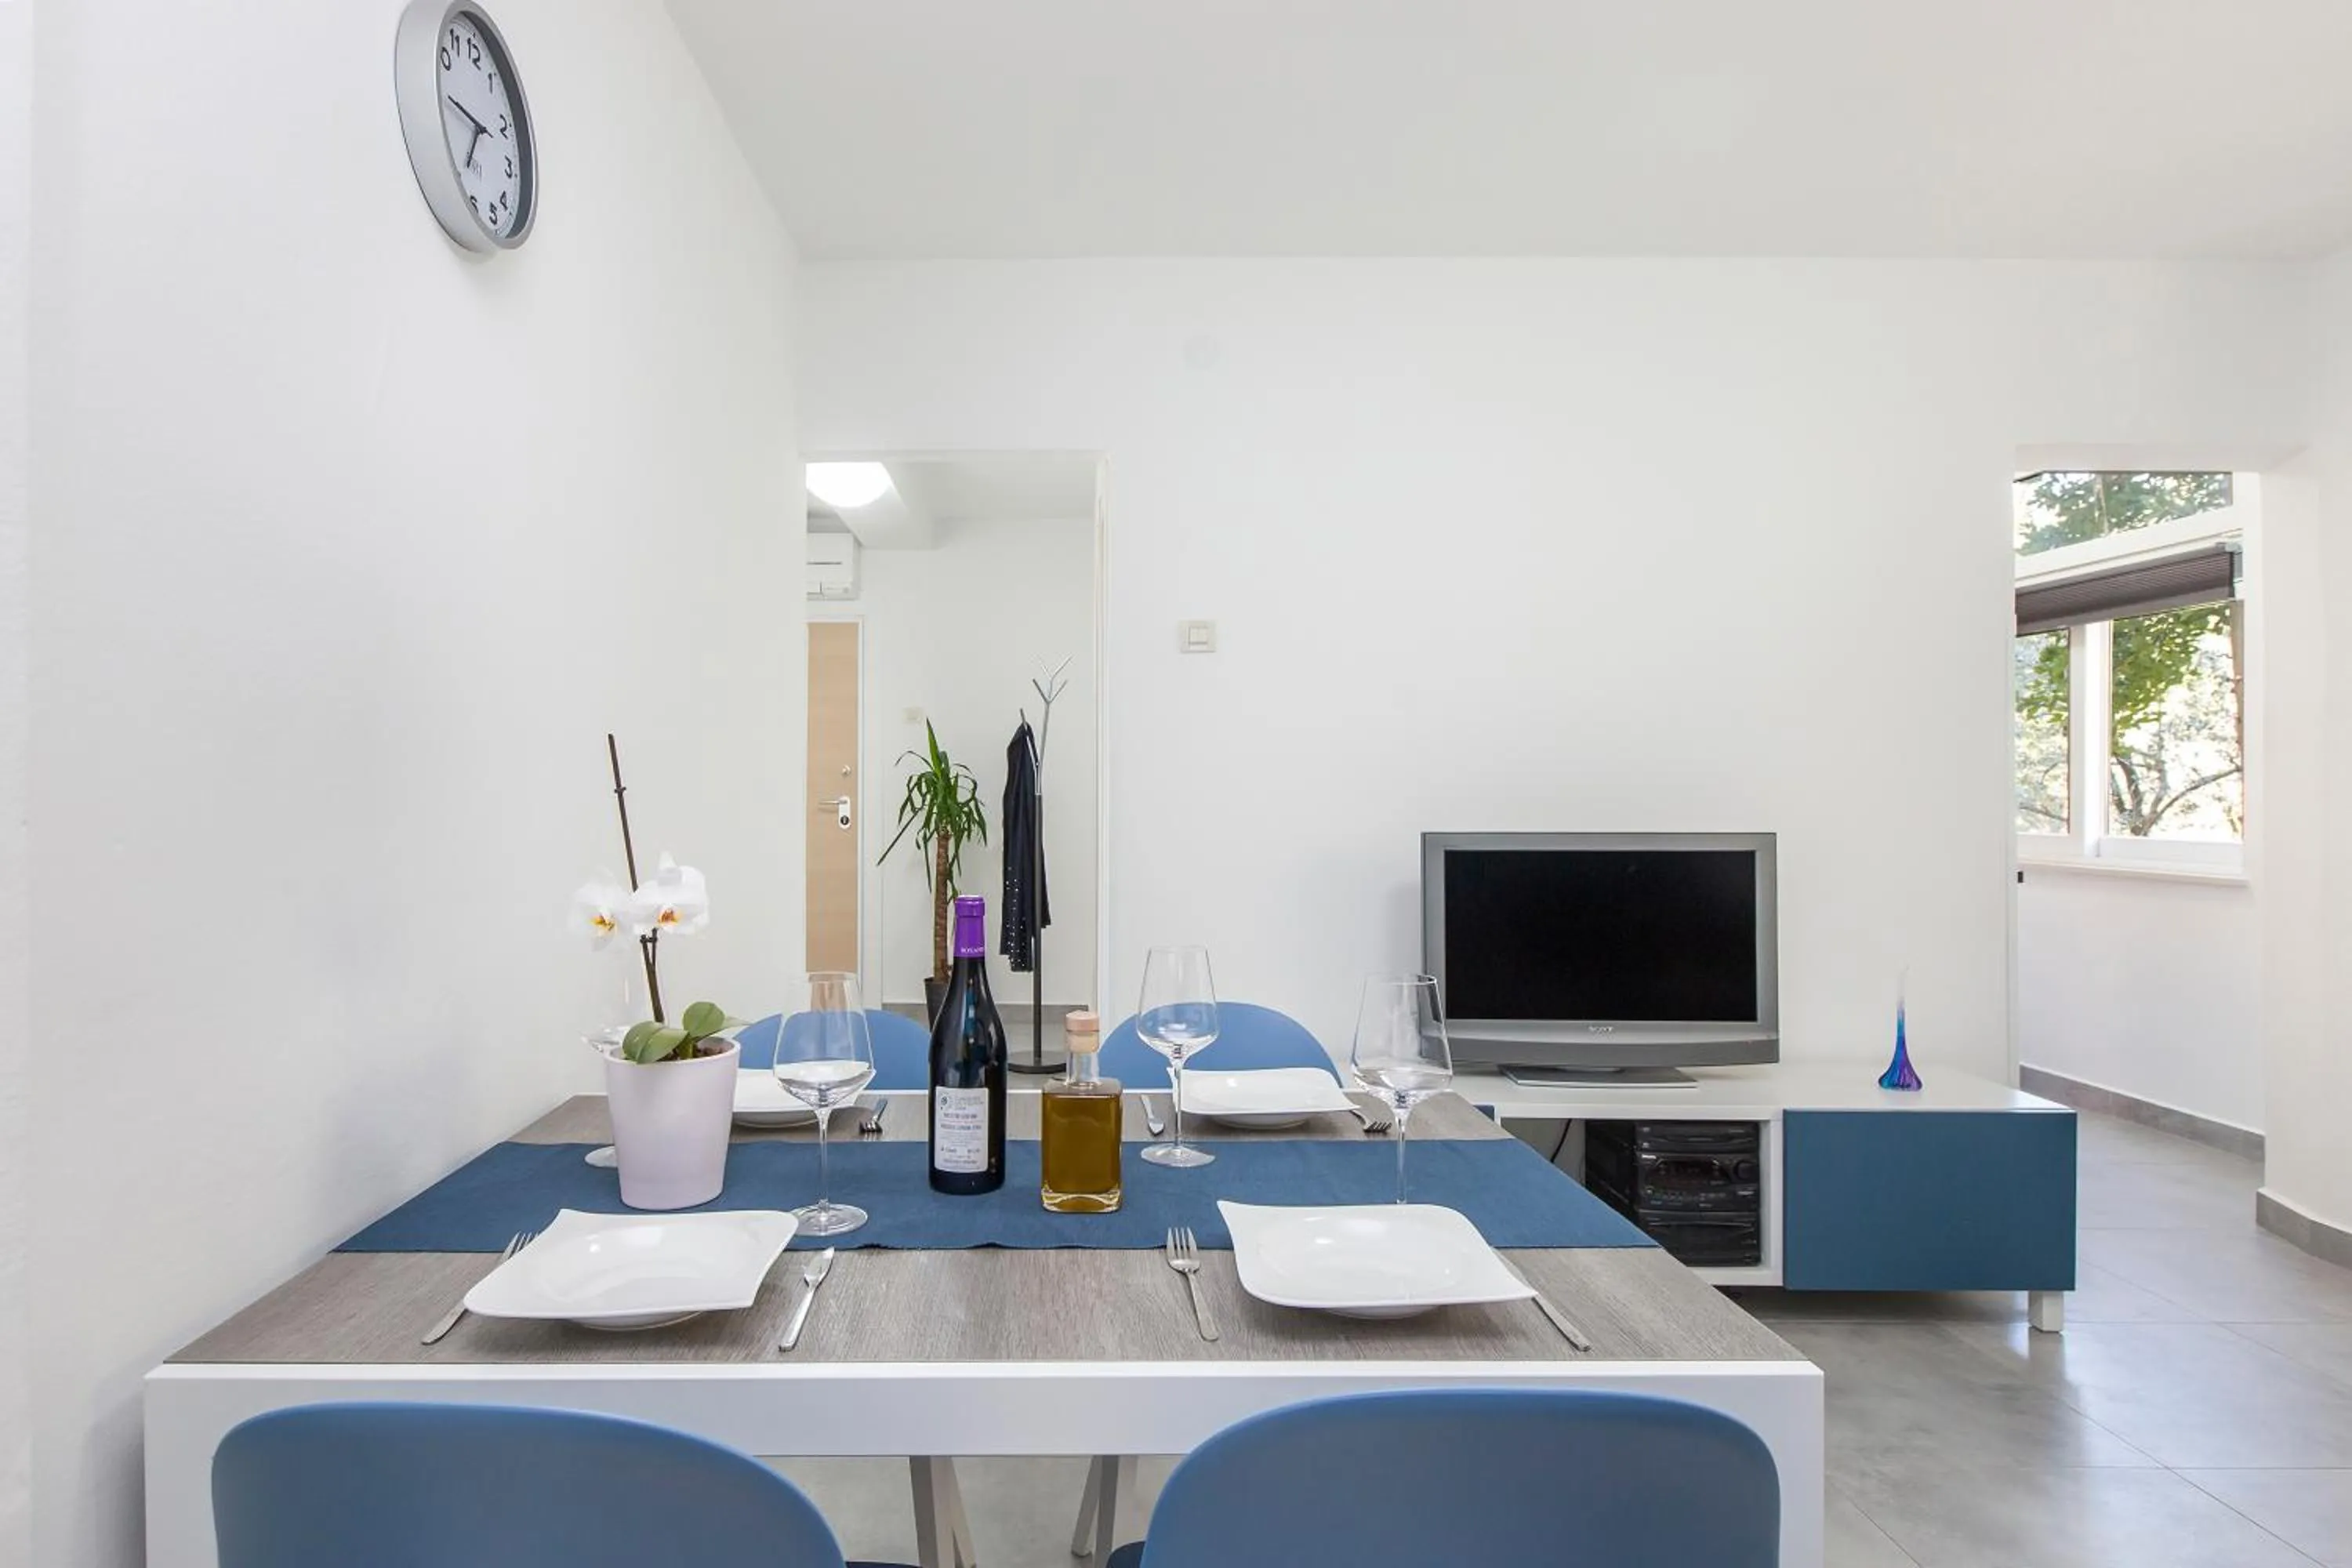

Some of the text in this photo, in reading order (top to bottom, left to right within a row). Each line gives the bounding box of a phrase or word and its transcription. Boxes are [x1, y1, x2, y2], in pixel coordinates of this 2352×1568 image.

[450, 28, 459, 57] 11
[467, 37, 481, 70] 12
[488, 72, 493, 93] 1
[500, 114, 508, 140] 2
[504, 154, 513, 179] 3
[489, 201, 498, 225] 5
[500, 191, 508, 210] 4
